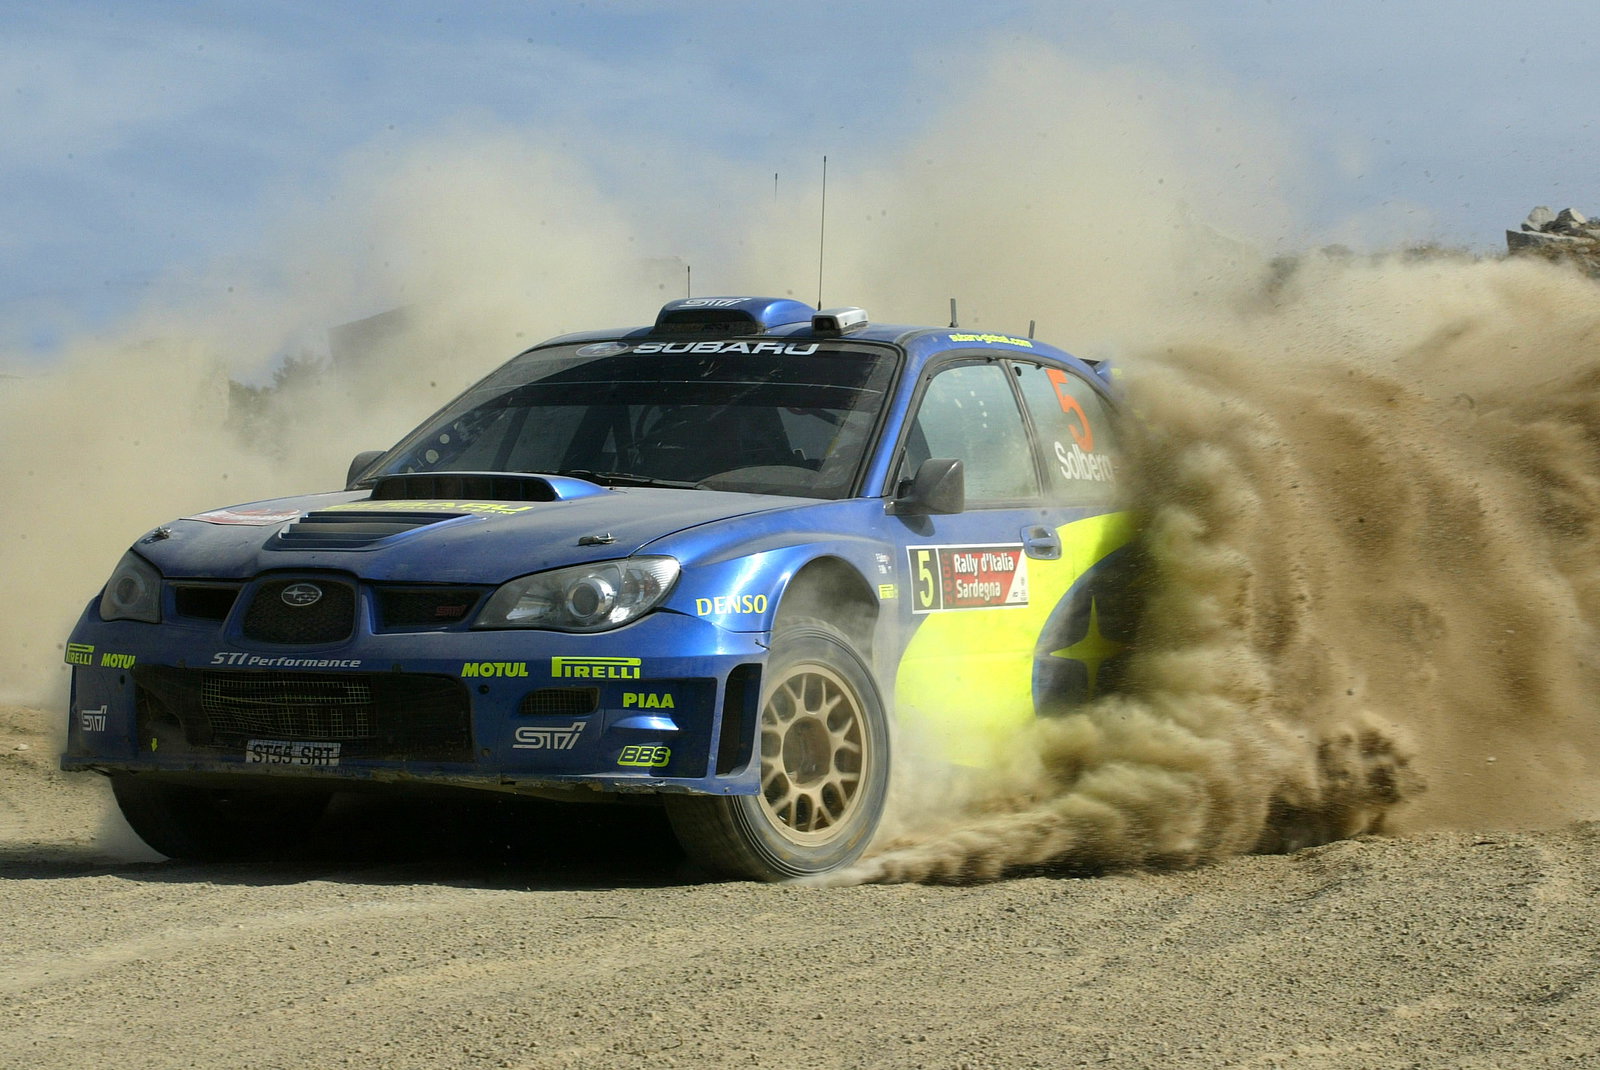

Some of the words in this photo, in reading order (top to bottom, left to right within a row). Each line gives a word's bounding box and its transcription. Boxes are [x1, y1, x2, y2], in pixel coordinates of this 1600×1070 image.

[632, 341, 820, 356] SUBARU
[1046, 368, 1094, 453] 5
[954, 553, 978, 576] Rally
[981, 552, 1015, 572] d'Italia
[917, 550, 934, 608] 5
[956, 579, 1001, 601] Sardegna
[696, 594, 768, 616] DENSO
[211, 652, 249, 665] STI
[248, 656, 362, 668] Performance
[461, 662, 529, 678] MOTUL
[551, 656, 641, 679] PIRELLI
[623, 692, 675, 709] PIAA
[300, 745, 334, 766] SRT
[617, 745, 671, 767] BBS
